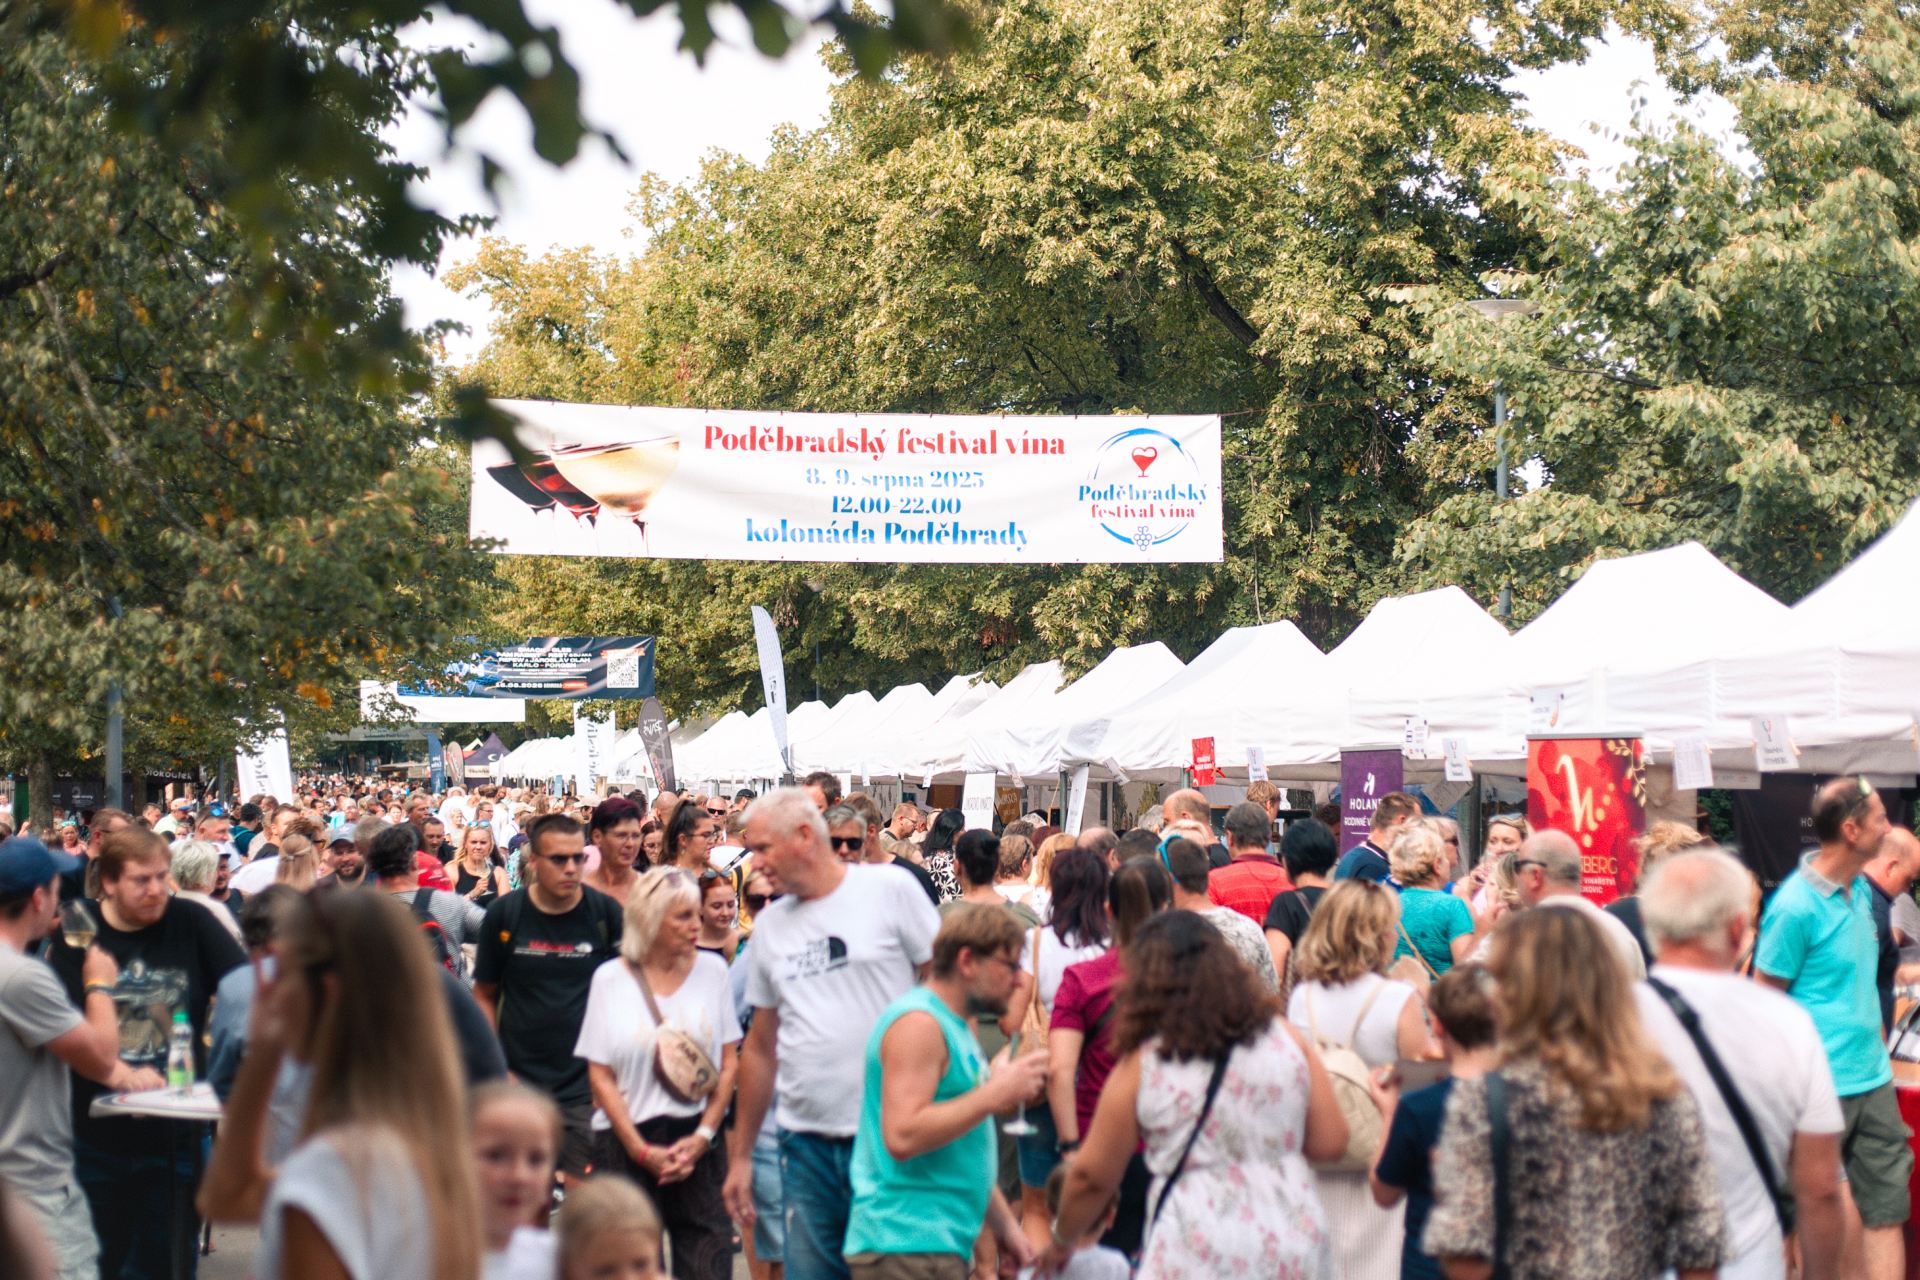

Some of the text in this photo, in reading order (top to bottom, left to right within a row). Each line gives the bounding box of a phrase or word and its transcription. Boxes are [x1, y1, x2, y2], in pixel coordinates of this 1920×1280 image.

[704, 425, 1066, 461] Poděbradský festival vína
[806, 467, 985, 492] 8. 9. srpna 2025
[831, 495, 962, 514] 12.00-22.00
[1078, 483, 1208, 506] Poděbradský
[1091, 503, 1196, 518] festival vína
[745, 518, 1028, 552] kolonáda Poděbrady
